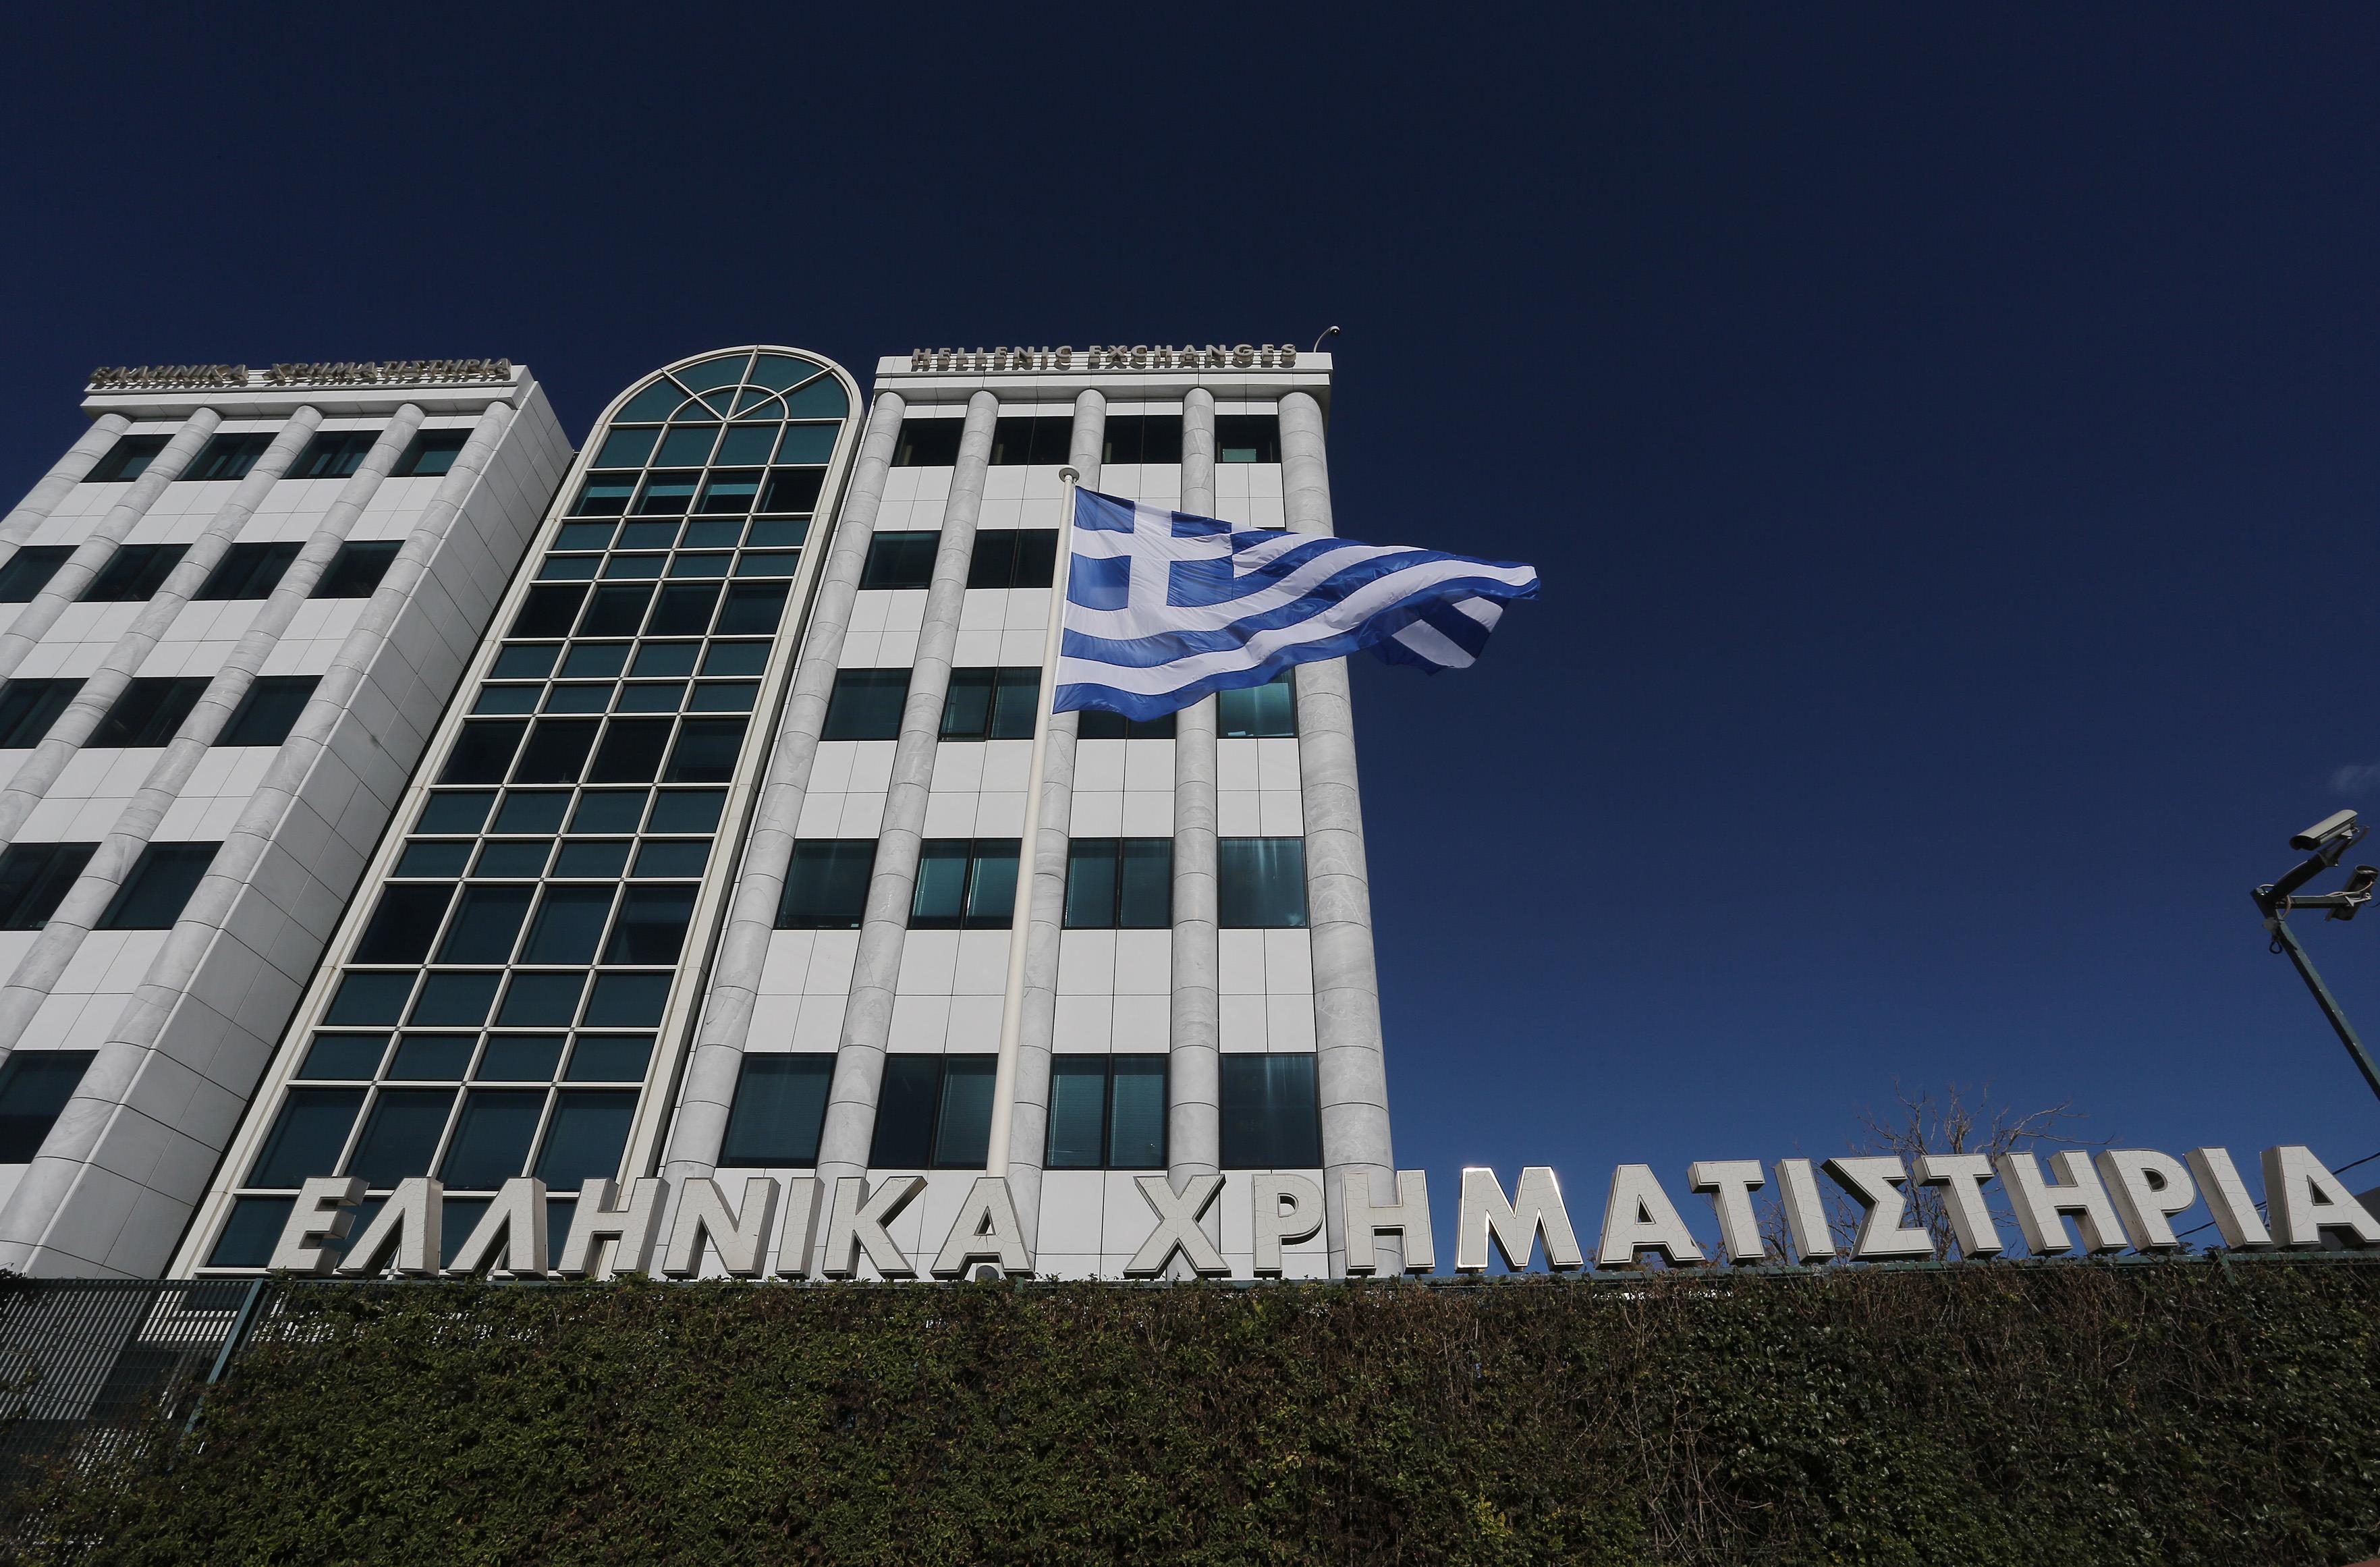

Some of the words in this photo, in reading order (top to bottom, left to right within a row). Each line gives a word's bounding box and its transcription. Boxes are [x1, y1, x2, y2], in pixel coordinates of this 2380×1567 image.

[911, 345, 1072, 366] HELLENIC
[1088, 343, 1297, 363] EXCHANGES
[267, 1176, 1035, 1278] ΕΛΛΗΝΙΚΑ
[1124, 1145, 2380, 1277] ΧΡΗΜΑΤΙΣΤΗΡΙΑ
